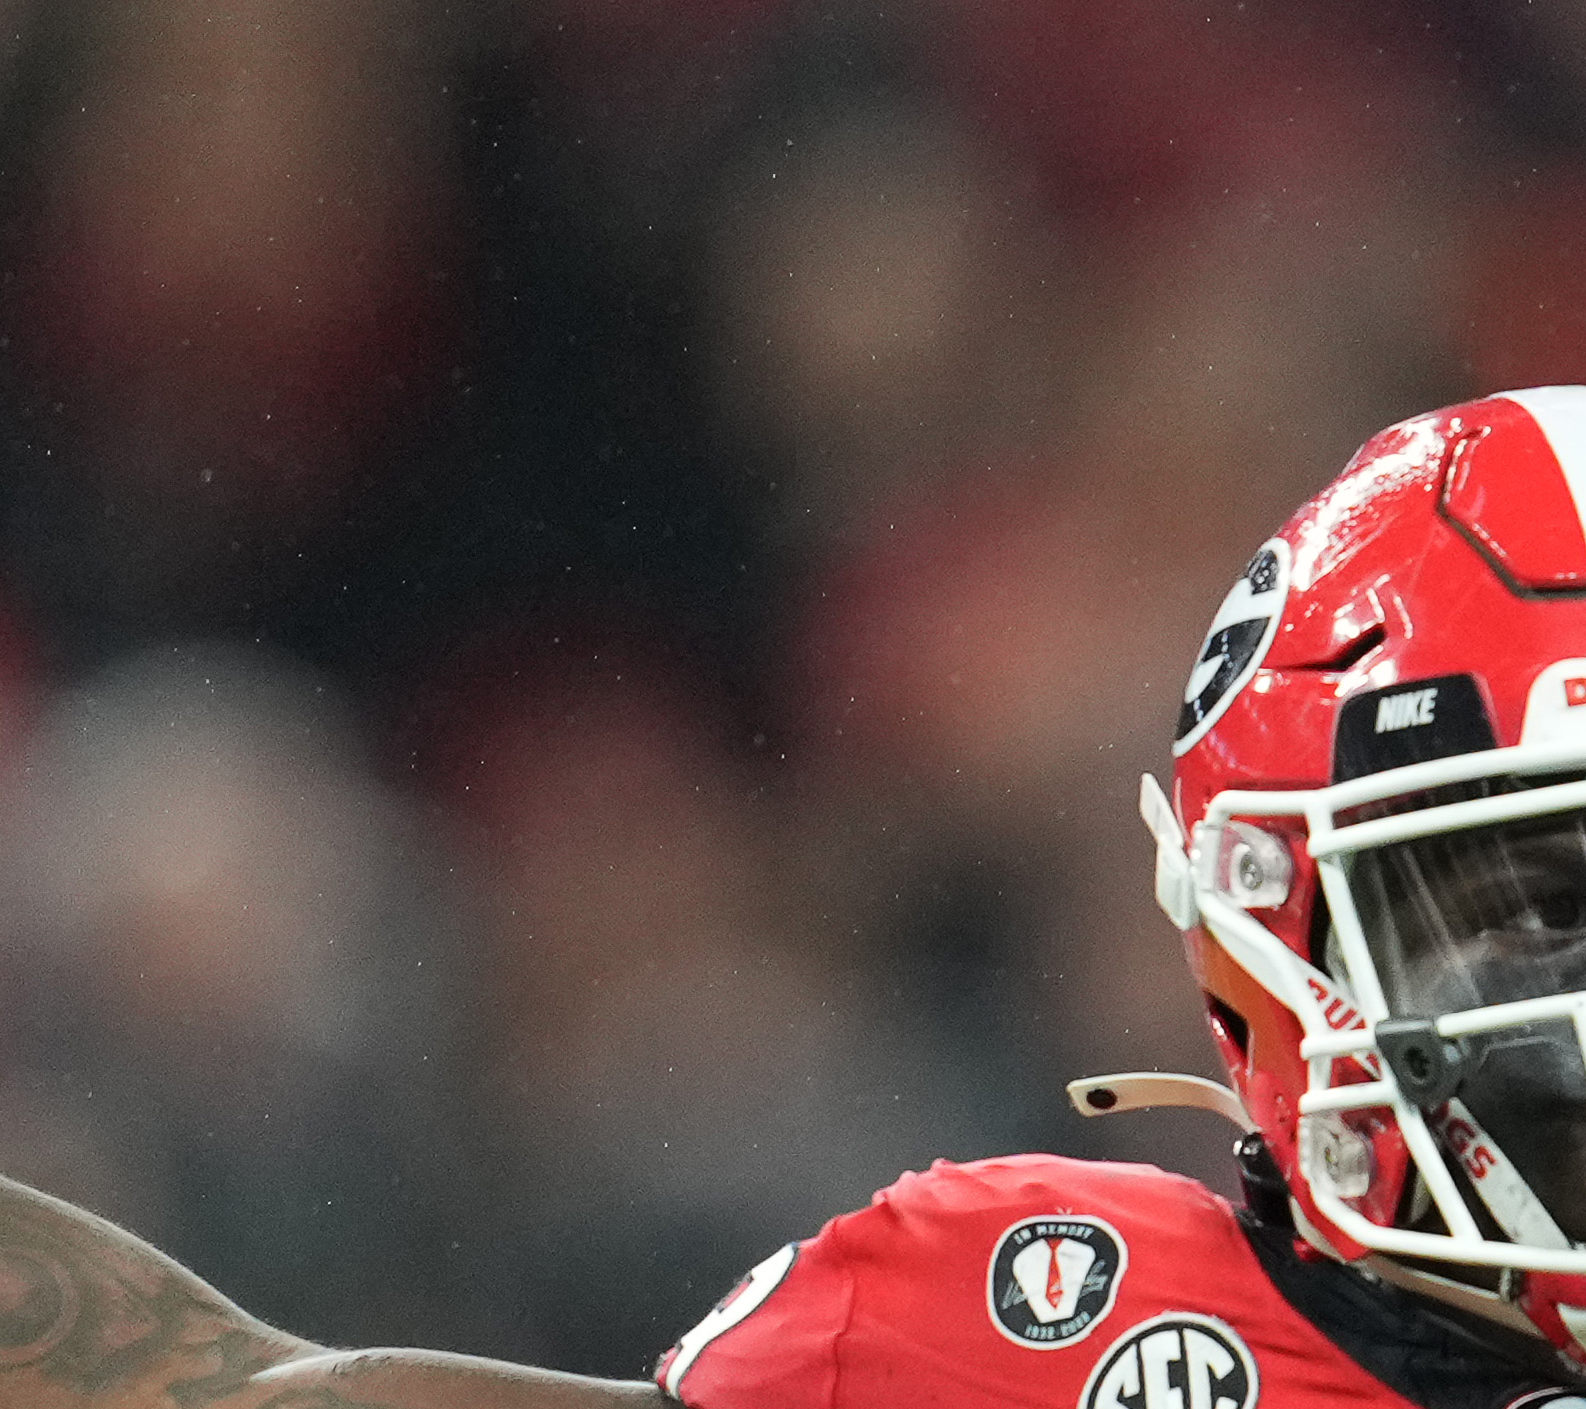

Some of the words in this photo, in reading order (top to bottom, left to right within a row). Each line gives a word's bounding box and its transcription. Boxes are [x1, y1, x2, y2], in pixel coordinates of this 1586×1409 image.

[1375, 687, 1439, 735] NIKE
[1014, 1228, 1032, 1246] IN
[1035, 1223, 1095, 1240] MEMORY
